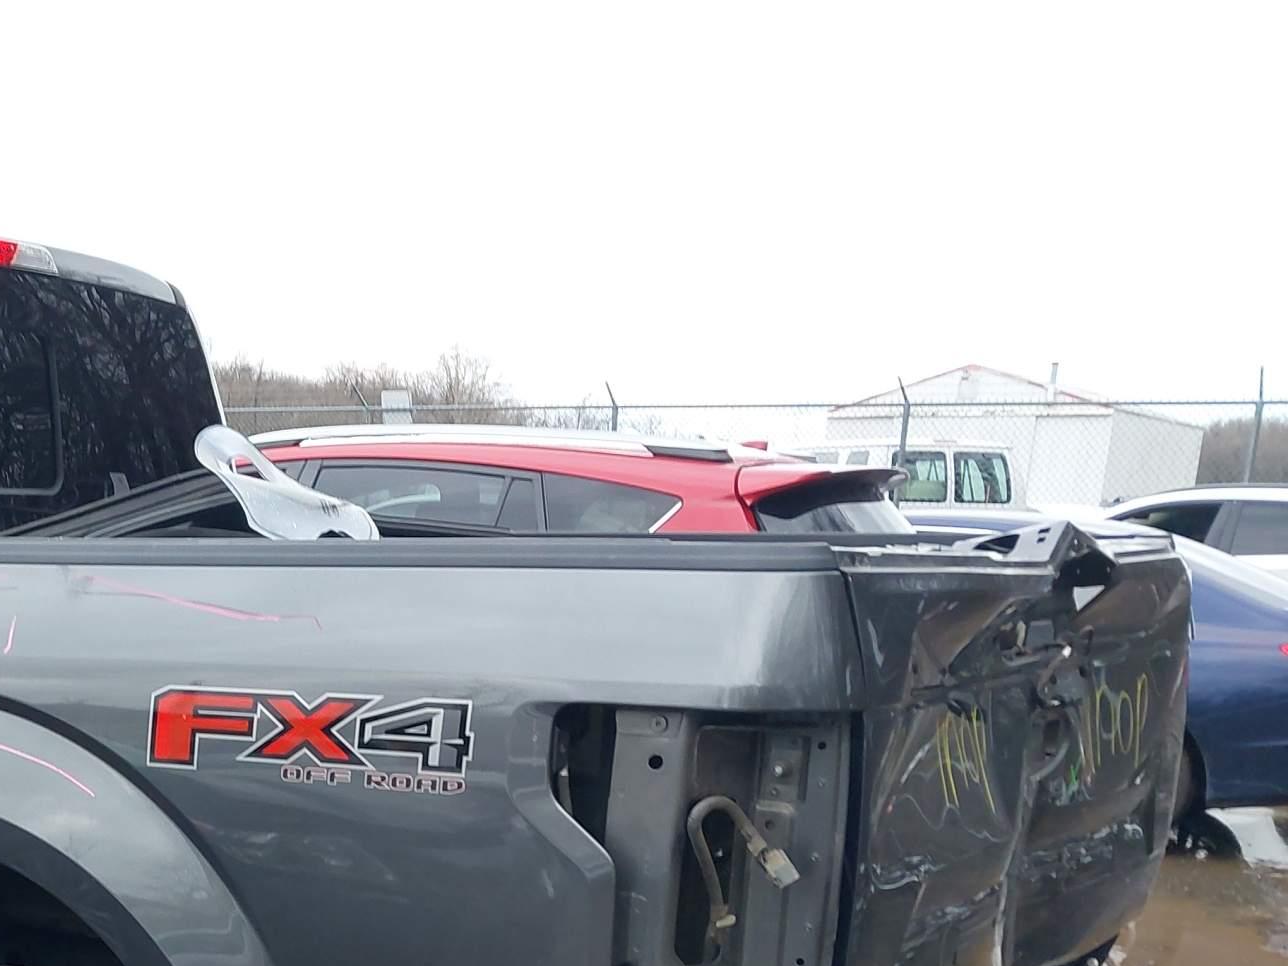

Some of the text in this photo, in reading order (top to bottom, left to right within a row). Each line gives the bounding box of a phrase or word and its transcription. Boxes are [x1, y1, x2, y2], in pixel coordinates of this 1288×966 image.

[147, 684, 475, 777] FX4
[280, 766, 468, 796] OFF ROAD
